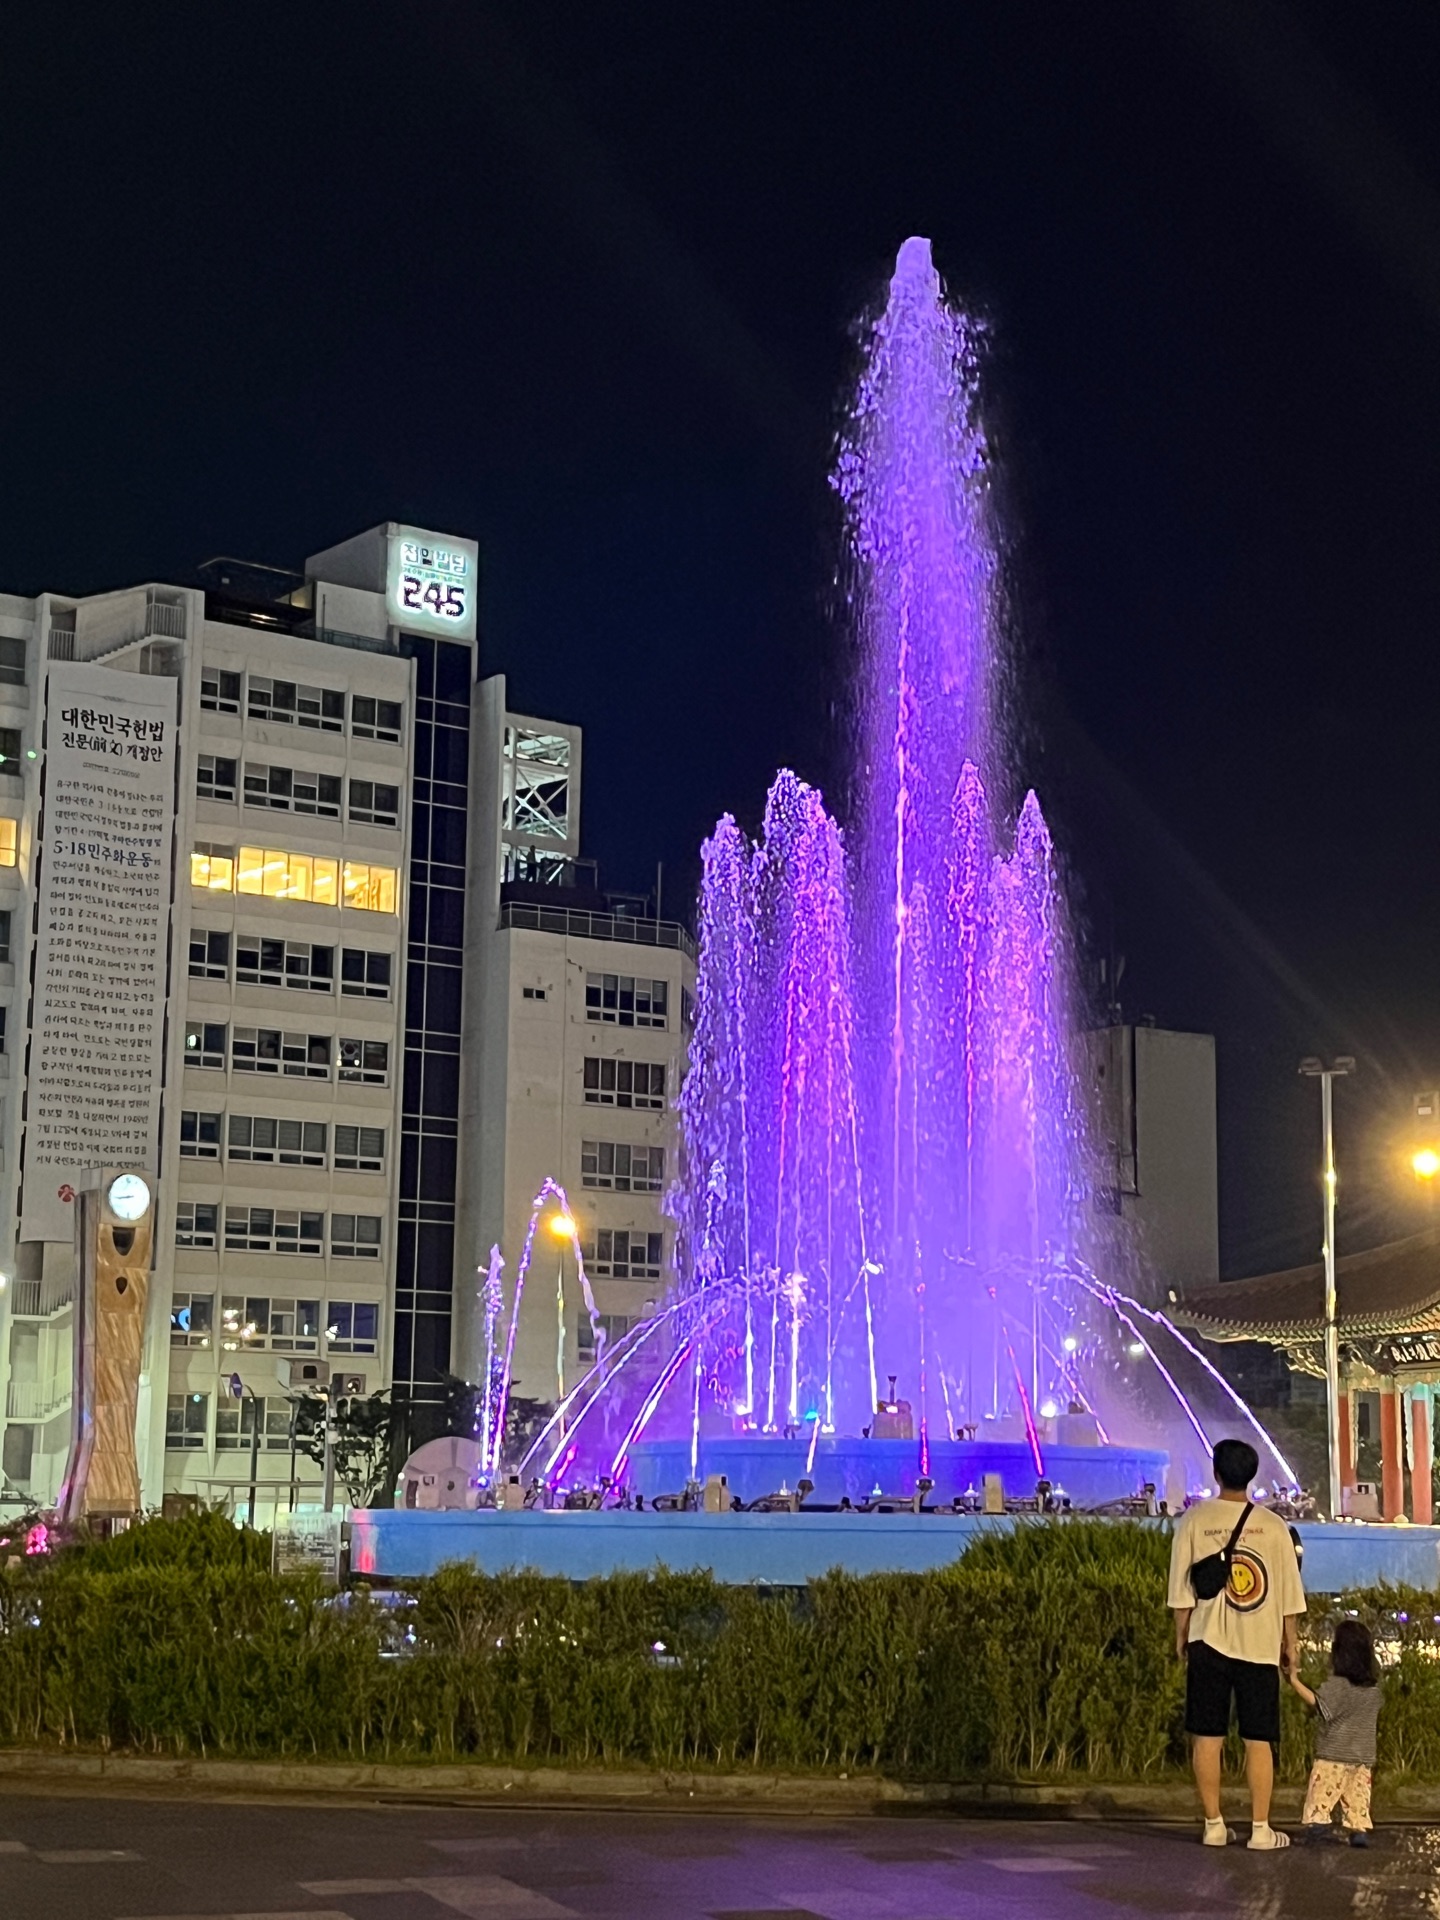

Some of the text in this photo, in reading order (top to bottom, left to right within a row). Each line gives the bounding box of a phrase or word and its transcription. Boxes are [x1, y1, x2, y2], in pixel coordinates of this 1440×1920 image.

[403, 574, 465, 617] 245
[61, 707, 165, 742] 대한민국헌법
[126, 743, 164, 763] 개정안
